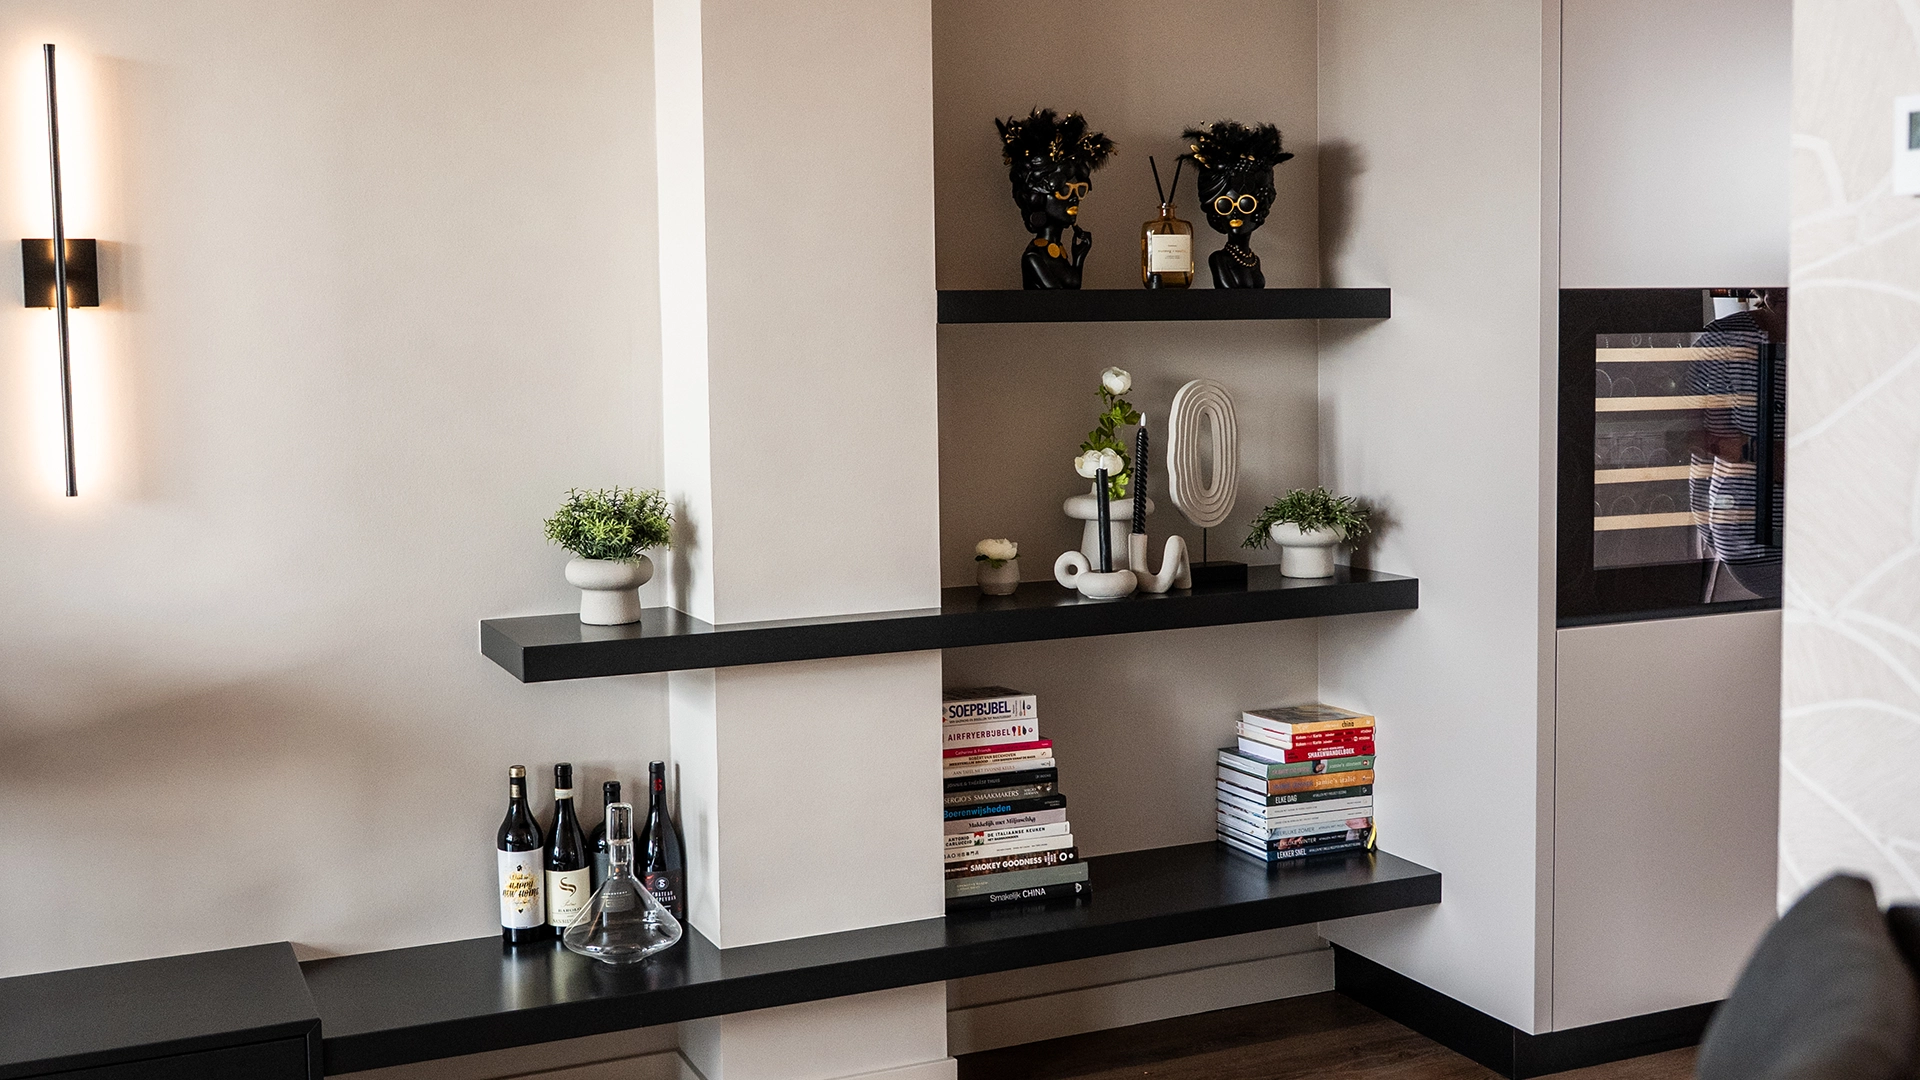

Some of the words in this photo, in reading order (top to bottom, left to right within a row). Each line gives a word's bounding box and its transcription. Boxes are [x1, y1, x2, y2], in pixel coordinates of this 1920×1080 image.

[944, 804, 1011, 818] Boerenwijsheden
[970, 861, 1001, 872] SMOKEY
[1002, 857, 1042, 868] GOODNESS
[1022, 888, 1046, 898] CHINA
